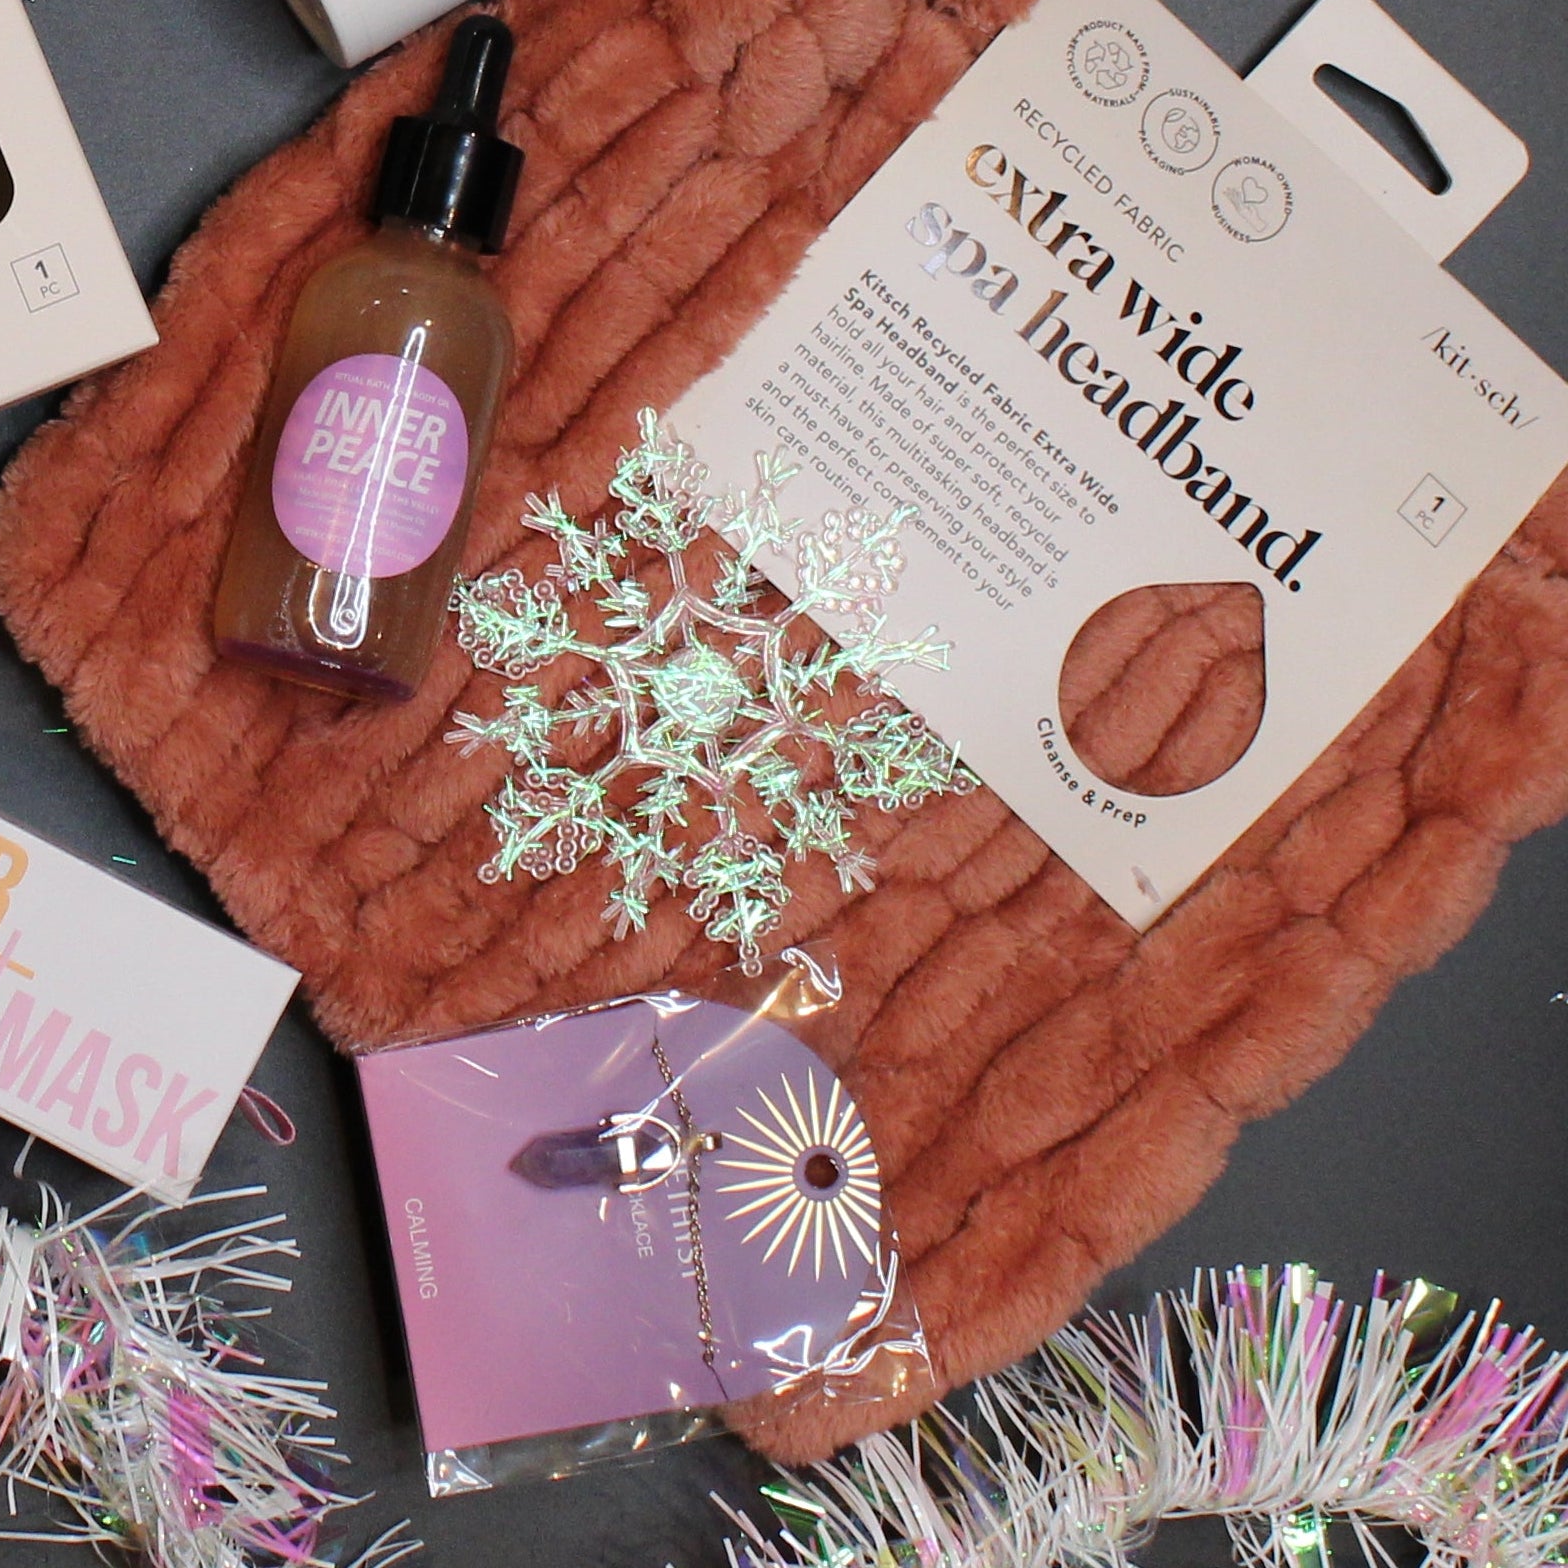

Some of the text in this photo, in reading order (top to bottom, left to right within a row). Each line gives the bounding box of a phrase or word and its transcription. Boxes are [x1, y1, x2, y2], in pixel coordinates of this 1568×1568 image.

[1014, 98, 1184, 262] RECYCLED FABRIC
[35, 260, 49, 279] 1
[39, 281, 61, 299] PC
[964, 145, 1254, 421] extra wide
[314, 392, 447, 454] INNER
[860, 270, 1118, 514] Kitsch Recycled Fabric Extra Wide
[906, 202, 1322, 592] spa headband.
[303, 430, 440, 493] PEACE
[1415, 509, 1435, 530] PC
[1432, 496, 1445, 513] 1
[1038, 718, 1078, 790] Cleanse
[1081, 789, 1096, 807] &
[405, 1198, 438, 1299] CALMING
